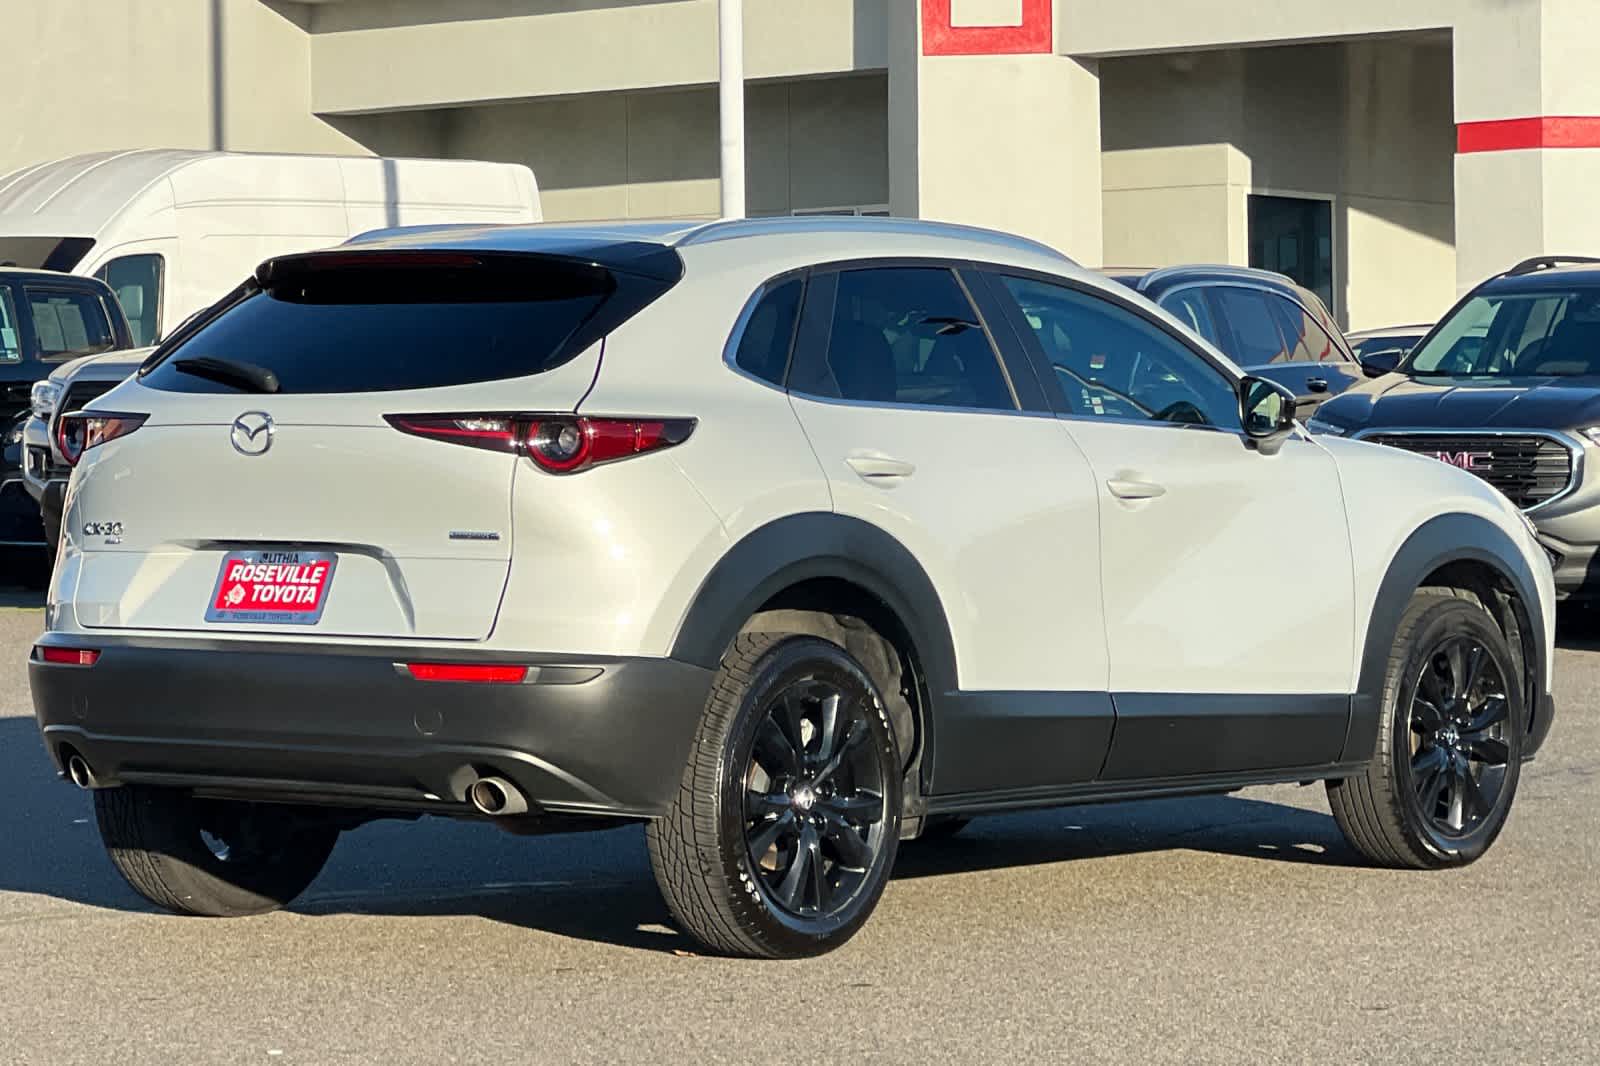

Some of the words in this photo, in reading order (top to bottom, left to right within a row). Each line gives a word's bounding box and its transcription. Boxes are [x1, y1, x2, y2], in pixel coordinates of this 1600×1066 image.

[1423, 451, 1494, 471] MC
[268, 552, 299, 564] LITHIA
[229, 564, 325, 584] ROSEVILLE
[251, 584, 317, 604] TOYOTA
